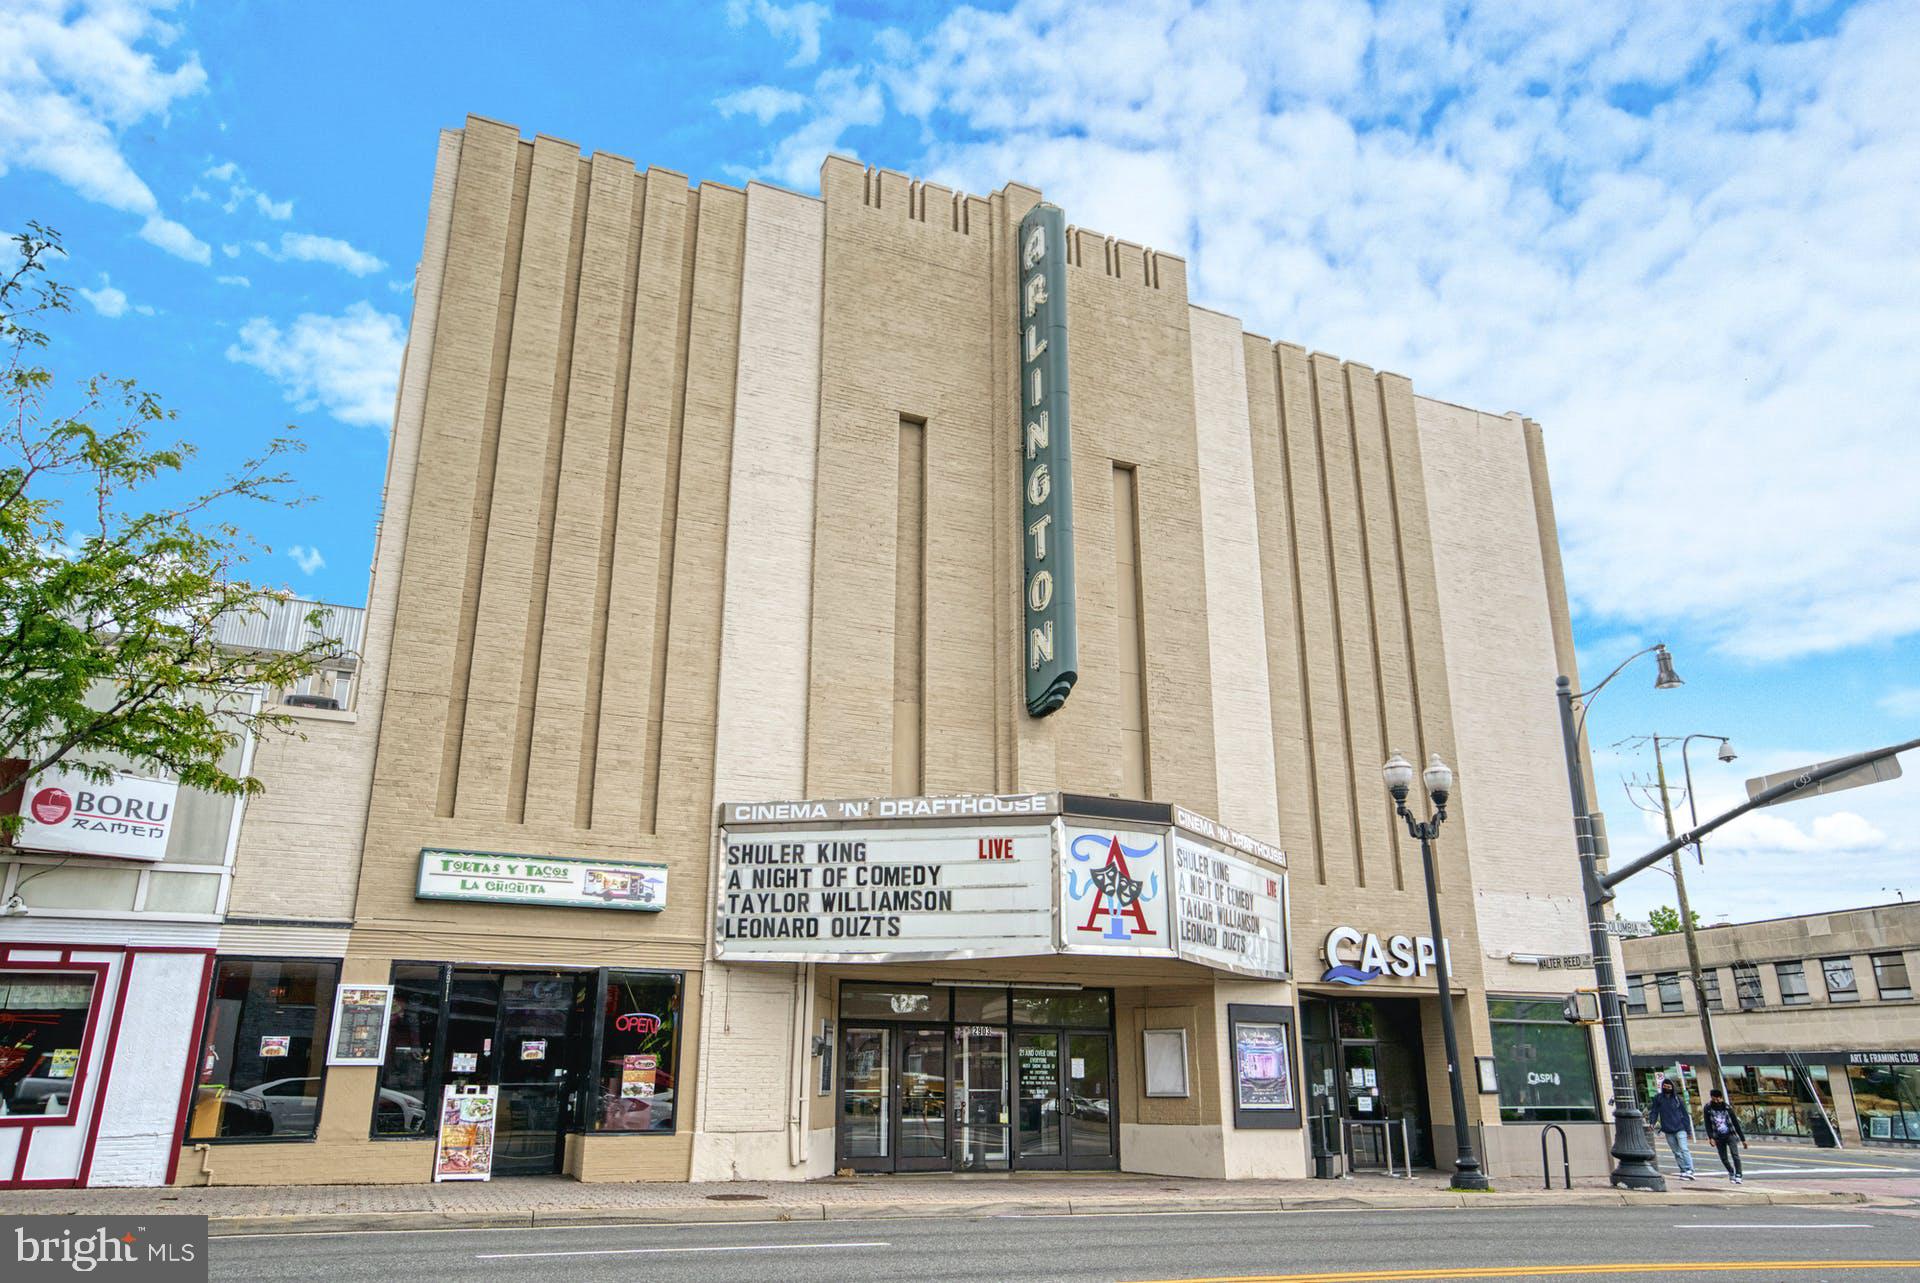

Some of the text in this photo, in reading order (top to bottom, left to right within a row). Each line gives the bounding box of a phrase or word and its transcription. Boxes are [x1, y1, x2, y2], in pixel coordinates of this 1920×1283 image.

[1023, 225, 1053, 670] ARLINGTON
[75, 791, 169, 822] BORU
[734, 802, 827, 821] CINEMA
[880, 795, 1047, 817] DRAFTHOUSE
[72, 819, 165, 839] RAMEN
[1177, 809, 1214, 837] CINEMA
[1232, 833, 1284, 864] DRAFTHOUSE
[728, 842, 866, 865] SHULER KING
[978, 838, 1013, 860] LIVE
[440, 859, 568, 879] TORTAS Y TACOS
[1177, 848, 1230, 882] SHULER KING
[460, 879, 545, 894] LA CHIQUITA
[728, 865, 942, 890] A NIGHT OF COMEDY
[1266, 878, 1277, 898] LIVE
[728, 890, 952, 914] TAYLOR WILLIAMSON
[1180, 872, 1254, 911] A NIGHT OF COMEDY
[726, 916, 900, 939] LEONARD OUZTS
[1180, 897, 1260, 935] TAYLOR WILLIAMSON
[1181, 921, 1246, 953] LEONARD OUZTS
[1324, 926, 1453, 977] CASPI
[1537, 958, 1561, 969] WALTER
[1563, 956, 1580, 968] REED
[616, 1014, 658, 1035] OPEN
[972, 1026, 992, 1036] 2903
[1850, 1053, 1919, 1063] ART & FRAMING CLUB
[1528, 1071, 1553, 1085] CASPI
